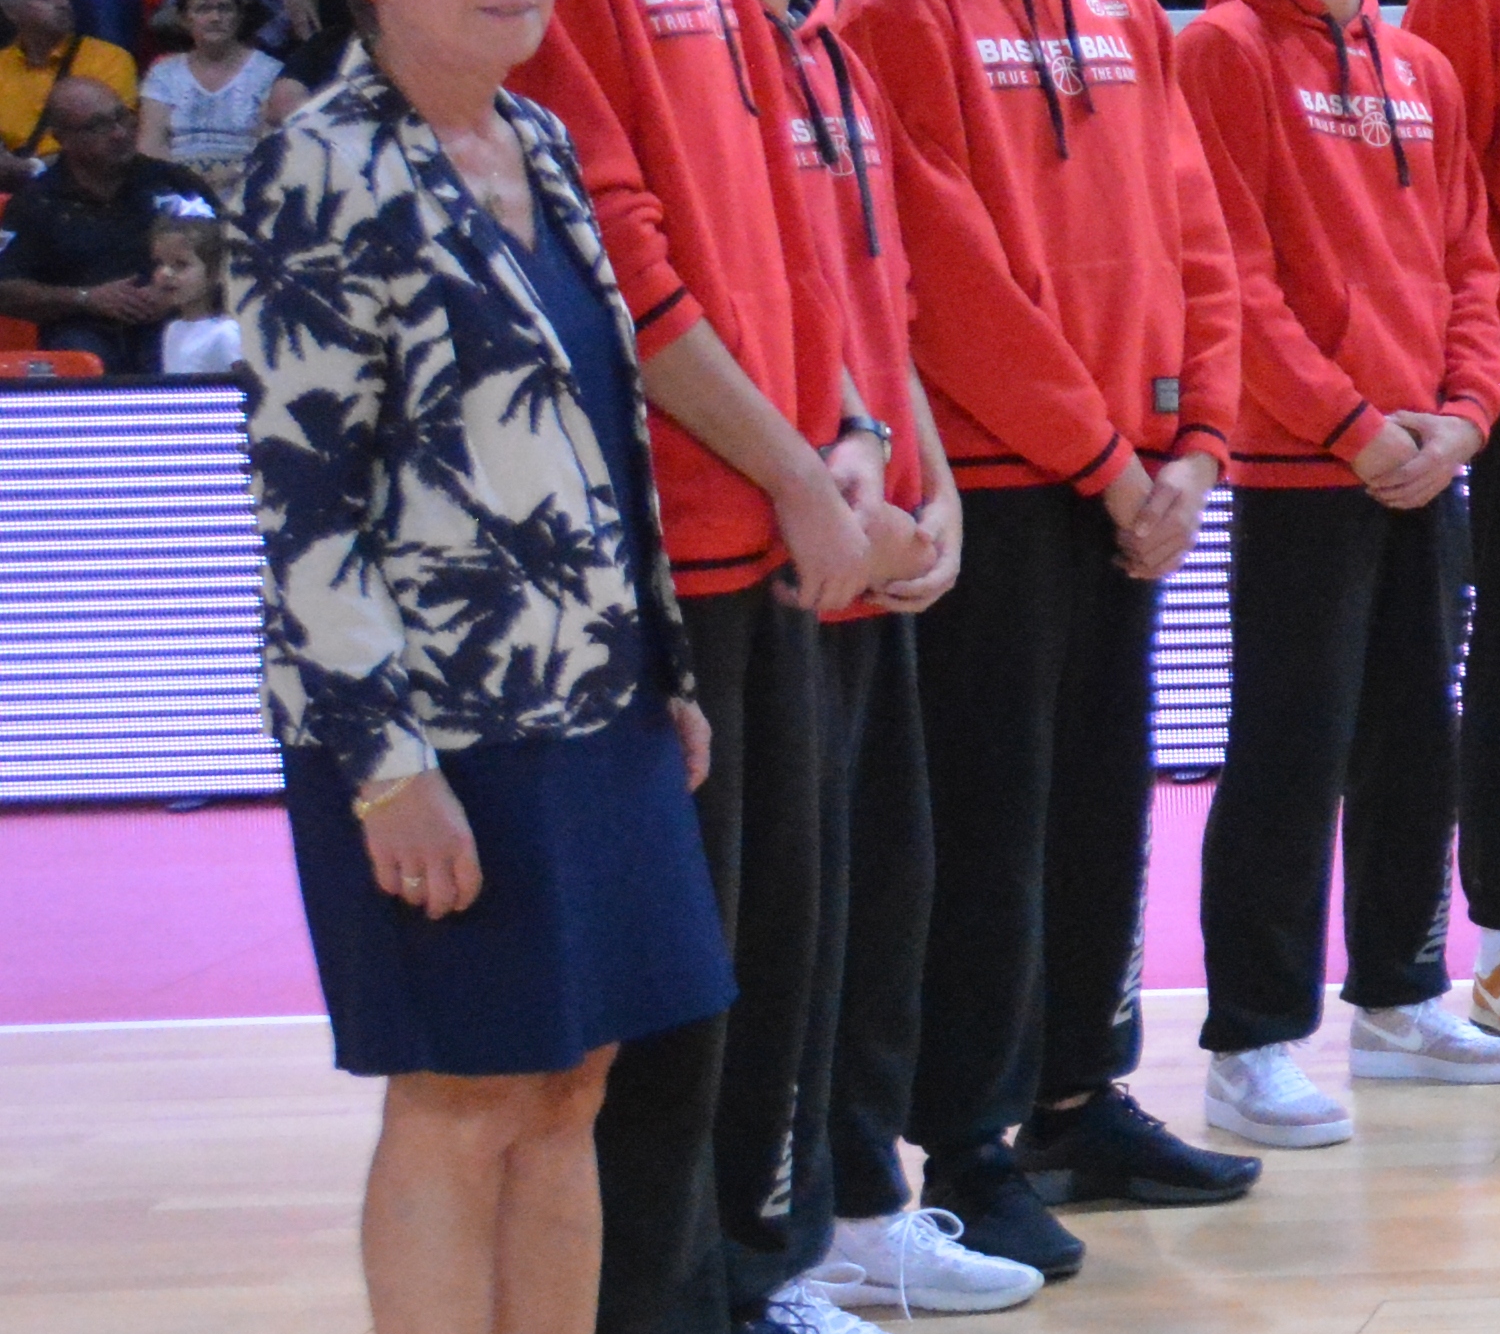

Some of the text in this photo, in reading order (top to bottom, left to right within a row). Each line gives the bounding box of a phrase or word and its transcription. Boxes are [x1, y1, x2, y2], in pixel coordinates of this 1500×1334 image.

[986, 70, 1029, 86] TRUE
[1090, 67, 1113, 81] THE
[1308, 115, 1337, 134] TRUE
[1341, 123, 1357, 137] TO
[1400, 126, 1414, 139] HE
